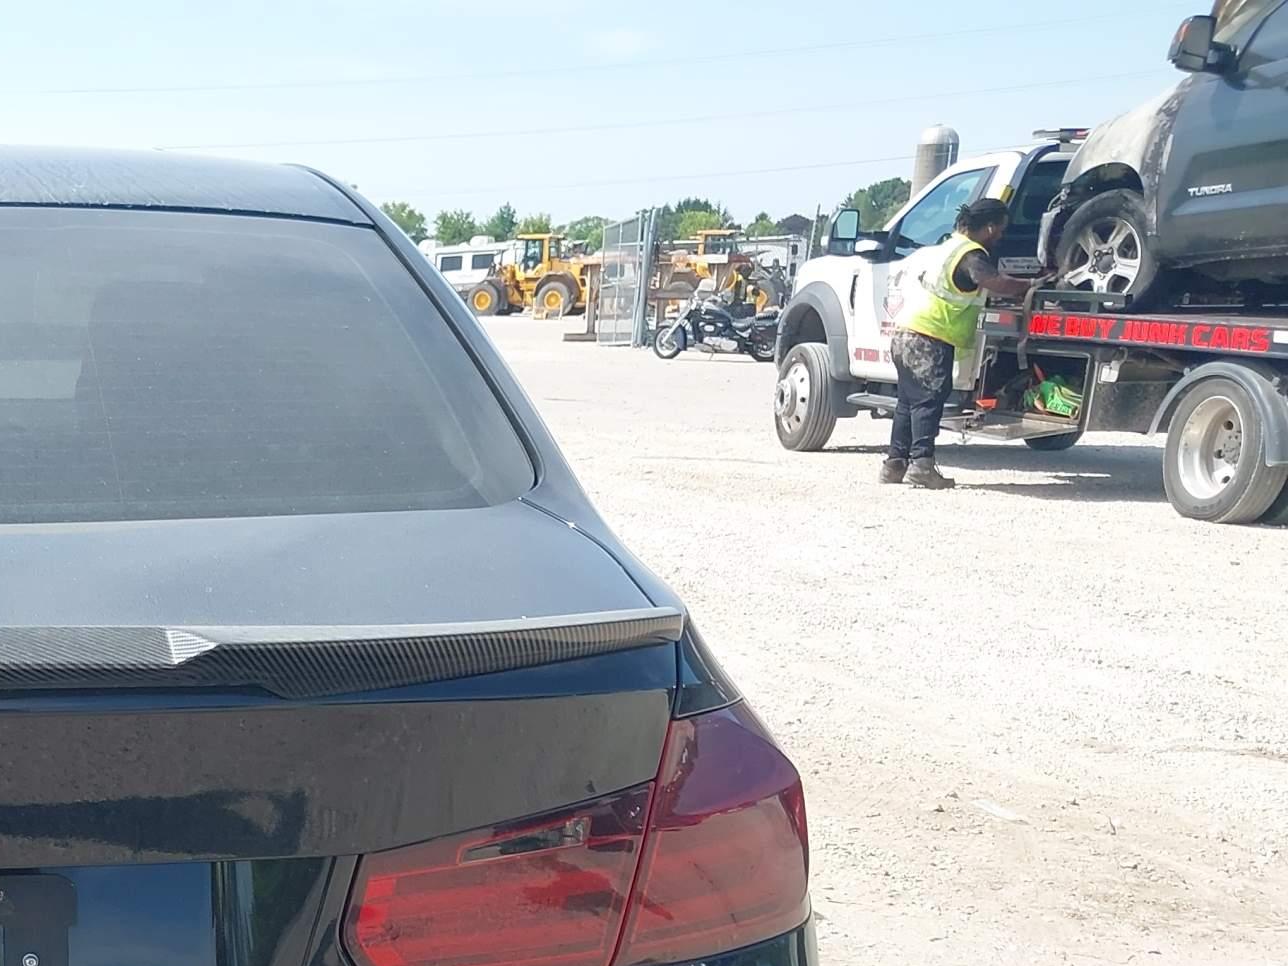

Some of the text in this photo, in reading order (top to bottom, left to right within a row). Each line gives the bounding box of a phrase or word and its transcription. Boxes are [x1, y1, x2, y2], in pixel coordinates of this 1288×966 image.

[1187, 183, 1232, 197] TUNDRA
[1028, 314, 1272, 352] WE BUY JUNK CARS
